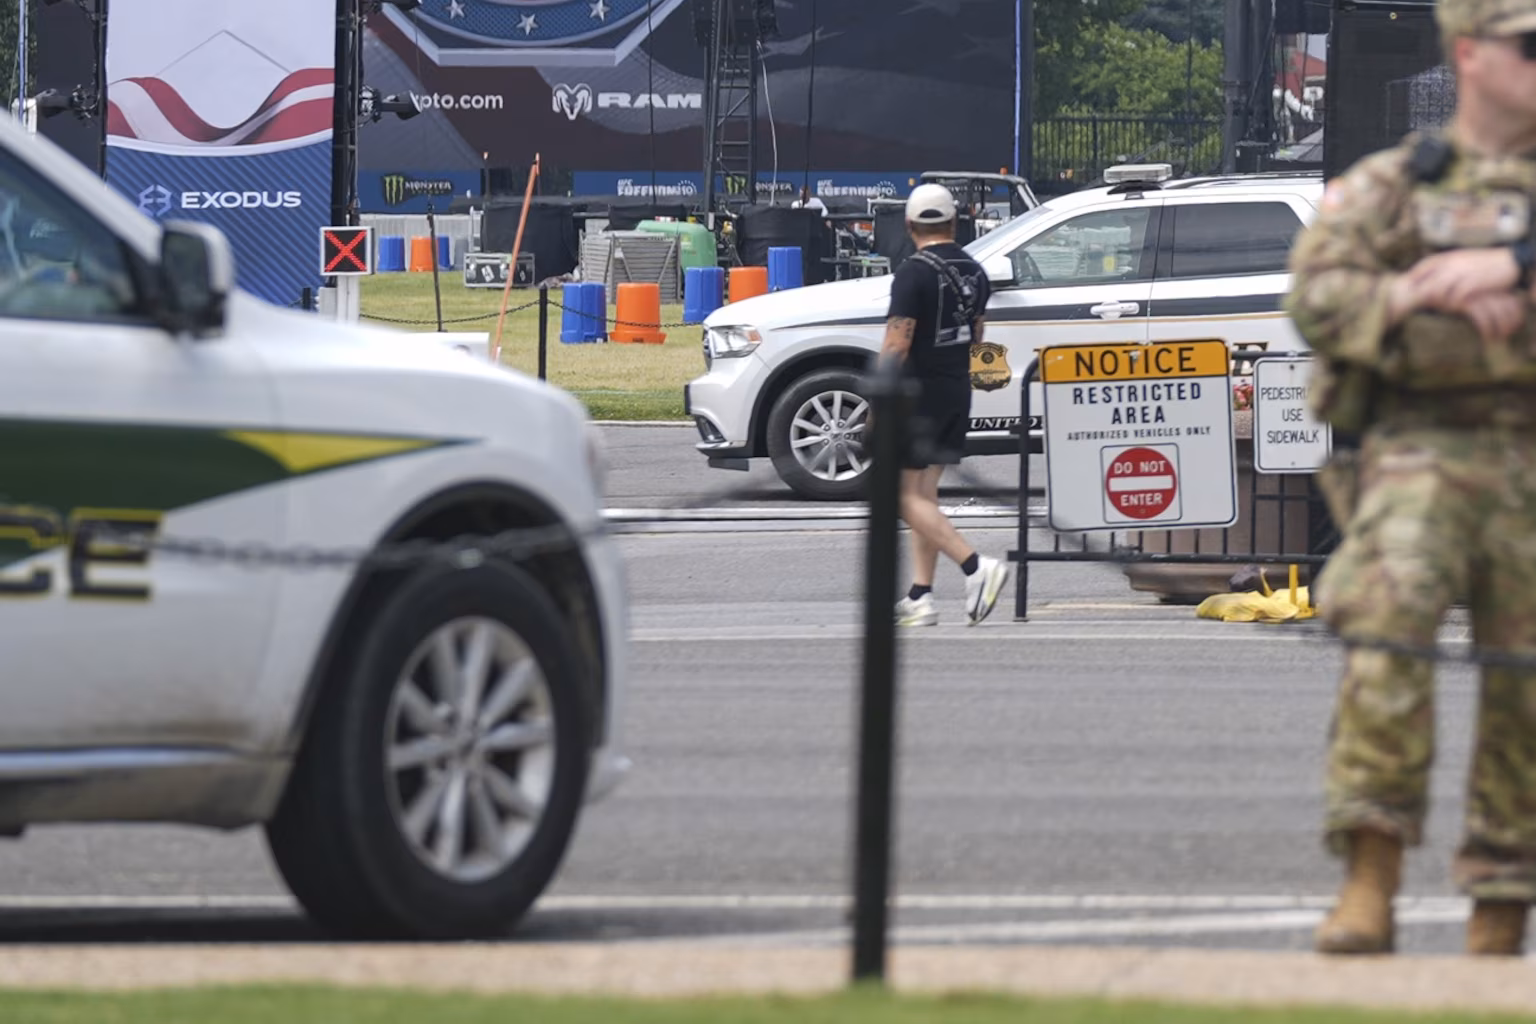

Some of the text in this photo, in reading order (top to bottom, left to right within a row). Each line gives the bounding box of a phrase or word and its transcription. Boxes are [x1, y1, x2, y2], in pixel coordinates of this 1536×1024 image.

[597, 92, 702, 109] RAM
[181, 191, 302, 208] EXODUS
[1075, 347, 1197, 376] NOTICE
[1073, 382, 1202, 404] RESTRICTED
[1261, 386, 1310, 400] PEDESTRI
[1111, 405, 1166, 424] AREA
[1282, 408, 1303, 421] USE
[1067, 426, 1211, 441] AUTHORIZED VEHICLES ONLY
[1267, 430, 1320, 444] SIDEWALK
[1114, 460, 1166, 474] DO NOT
[1120, 492, 1163, 507] ENTER
